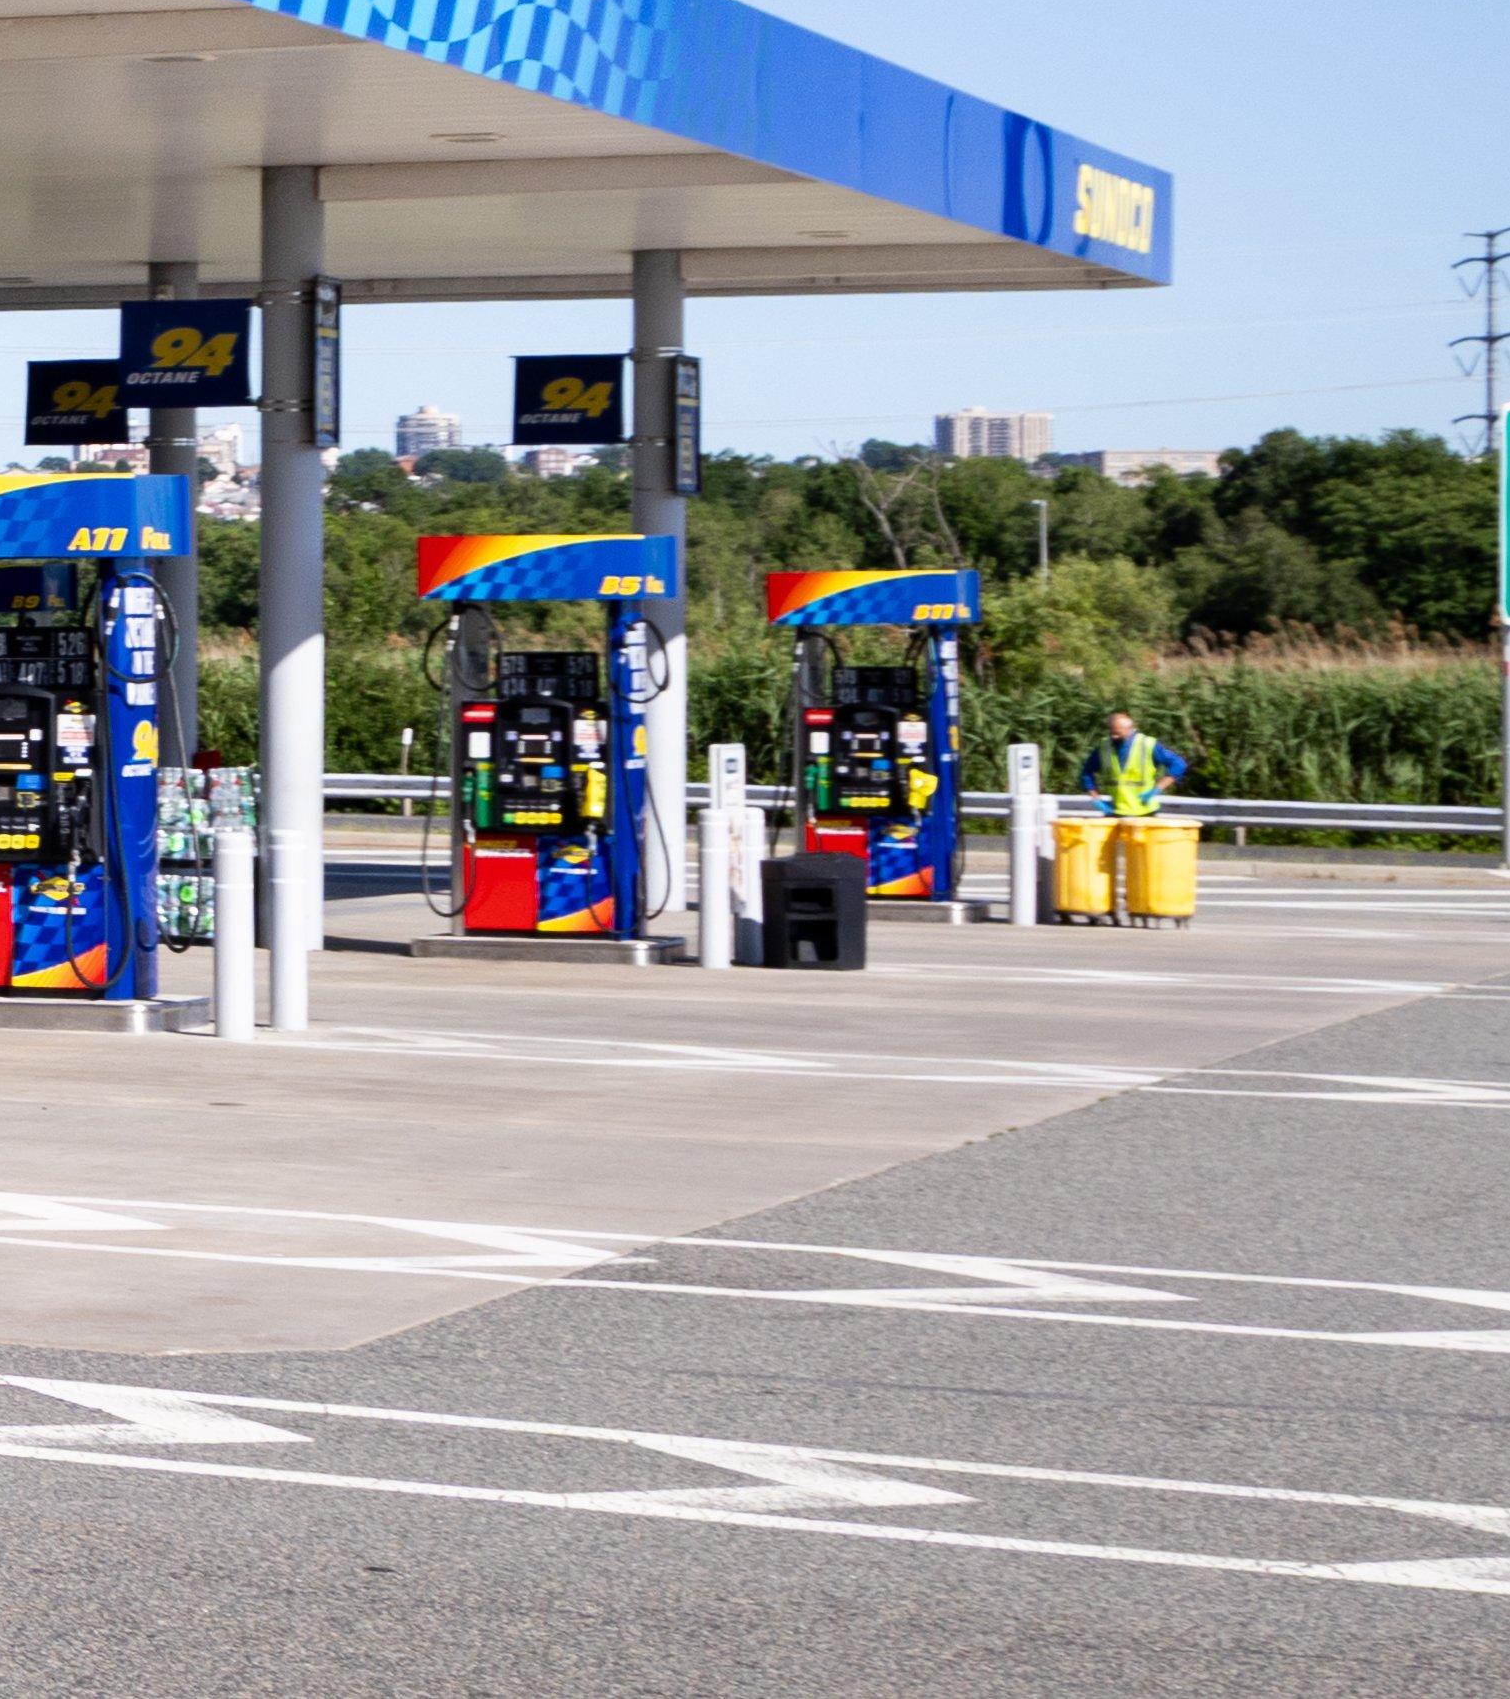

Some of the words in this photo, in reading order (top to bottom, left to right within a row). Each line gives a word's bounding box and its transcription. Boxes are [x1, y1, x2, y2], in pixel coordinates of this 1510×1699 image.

[149, 327, 238, 376] 94
[126, 371, 201, 385] OCTANE
[51, 381, 119, 418] 94
[540, 377, 614, 418] 94
[30, 414, 88, 426] OCTANE
[519, 412, 583, 425] OCTANE
[67, 527, 129, 551] A11
[599, 574, 643, 595] B5
